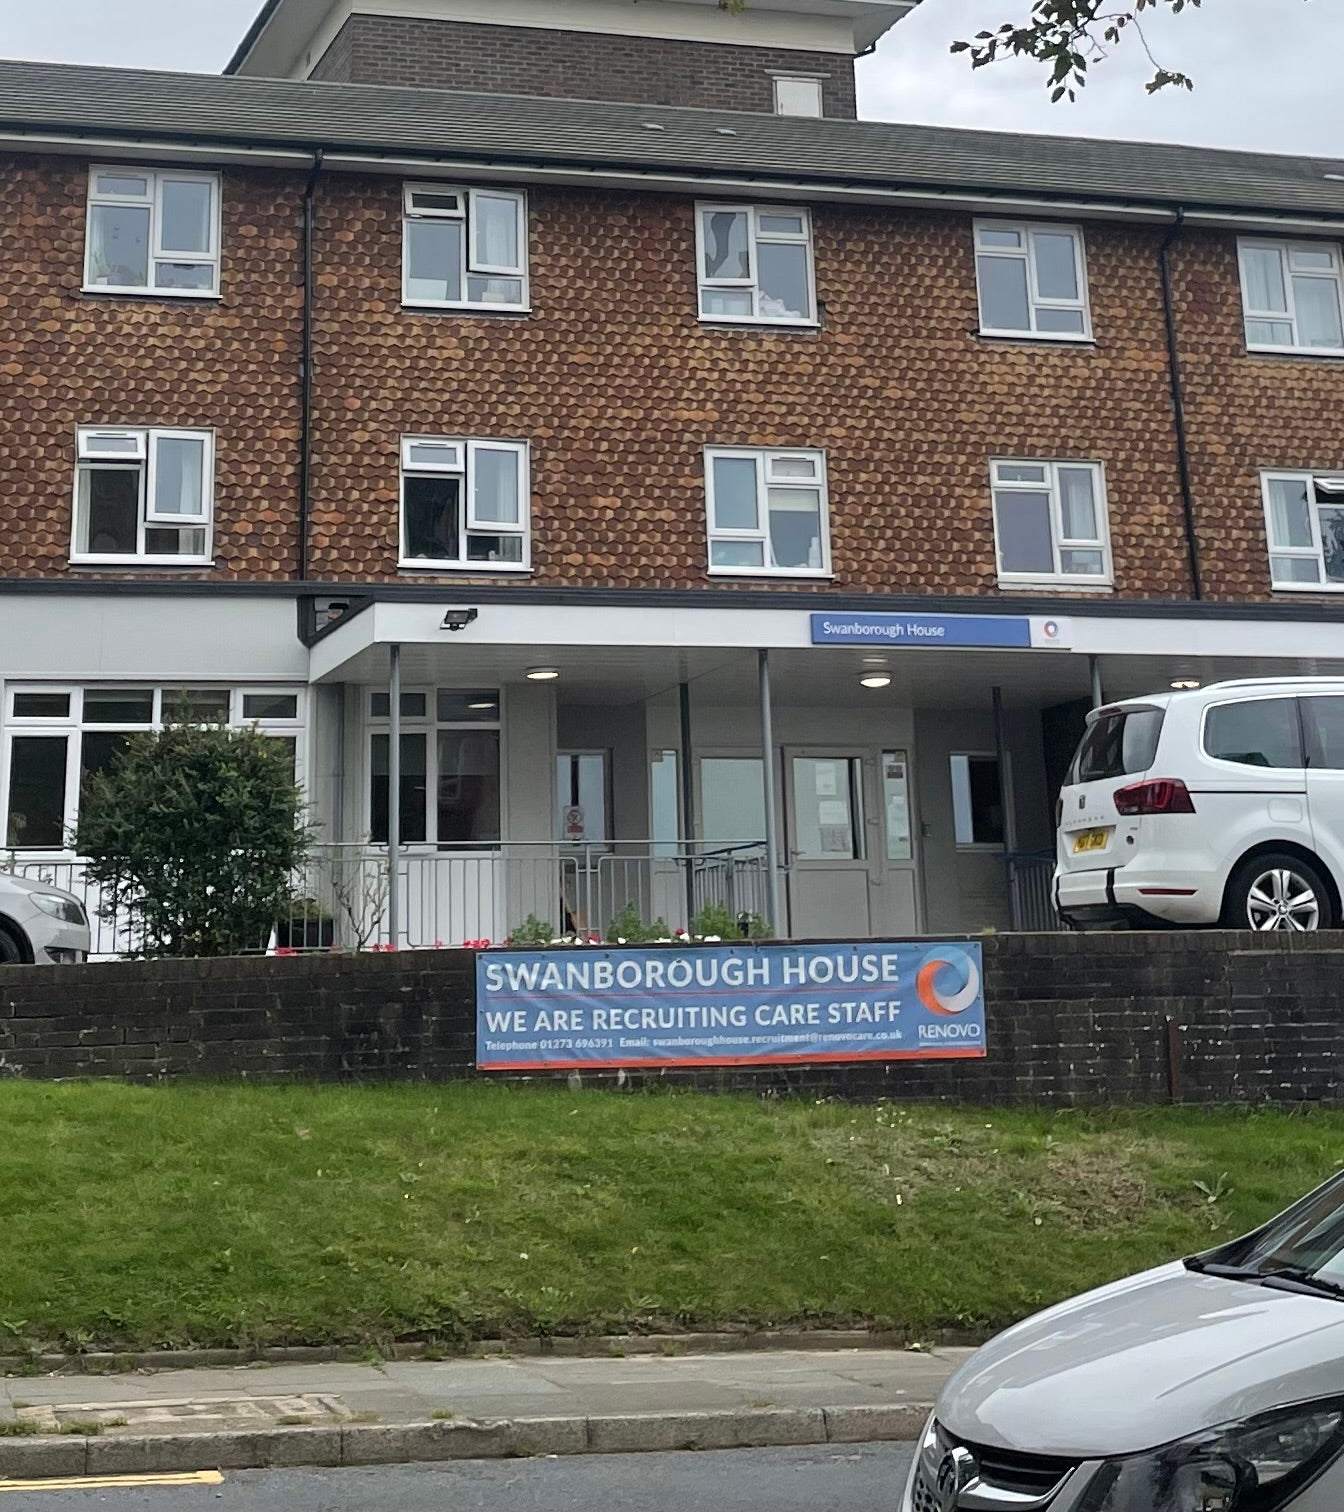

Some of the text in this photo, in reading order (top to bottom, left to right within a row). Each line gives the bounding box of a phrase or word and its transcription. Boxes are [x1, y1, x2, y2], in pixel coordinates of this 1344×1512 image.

[823, 621, 945, 638] Swanborough House
[485, 953, 900, 992] SWANBOROUGH HOUSE
[486, 1000, 901, 1033] WE ARE RECRUITING CARE STAFF
[918, 1023, 981, 1039] RENOVO
[485, 1040, 537, 1052] Telephone
[540, 1039, 573, 1049] 01273
[575, 1038, 613, 1049] 696391
[619, 1037, 650, 1047] Email:
